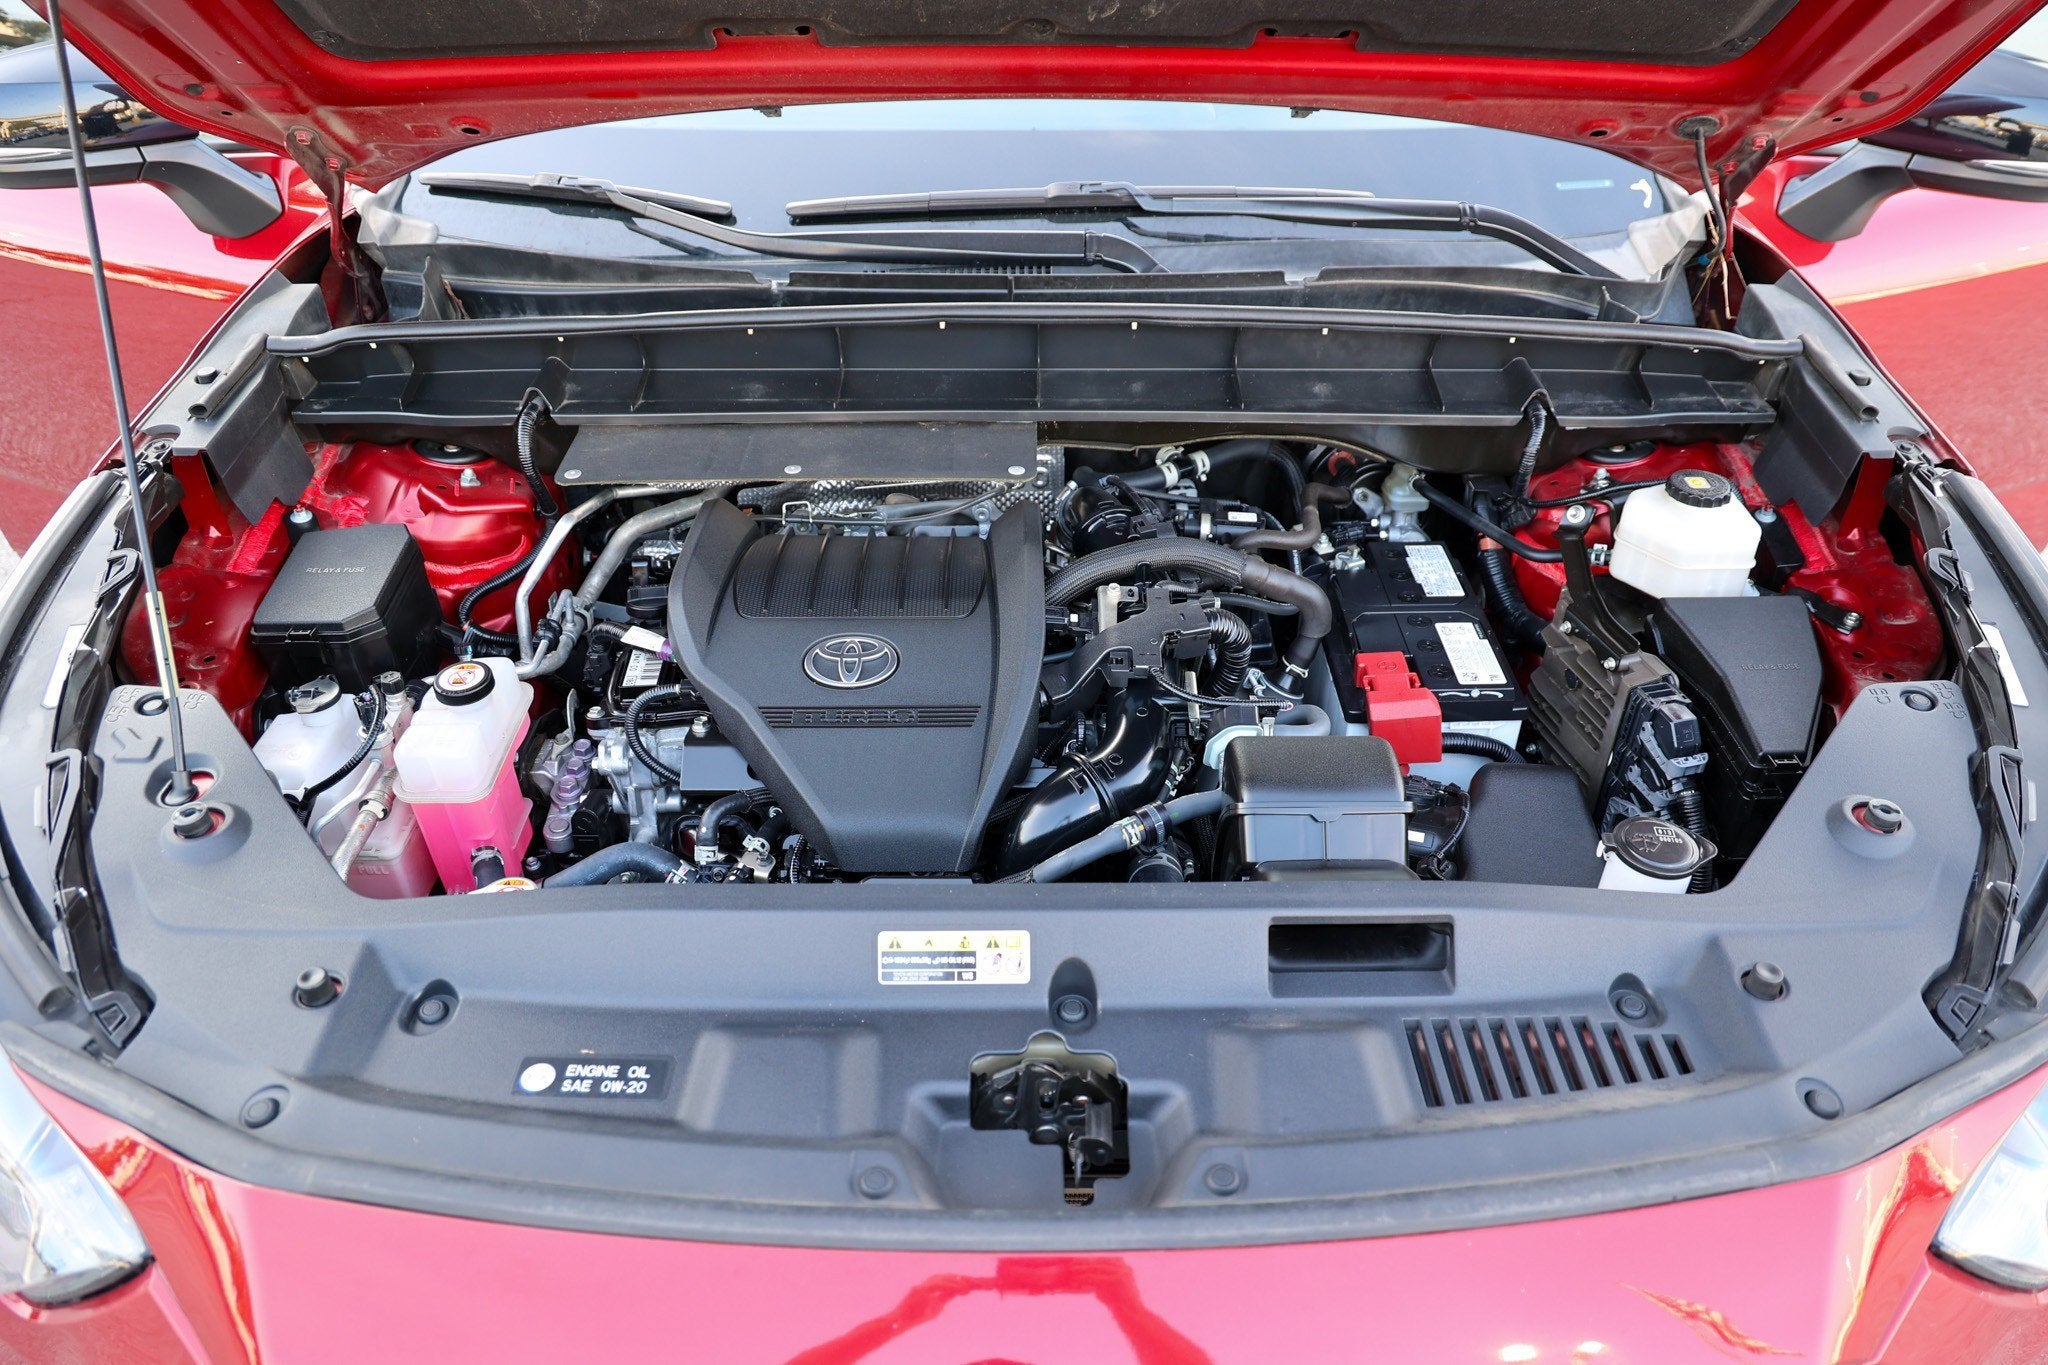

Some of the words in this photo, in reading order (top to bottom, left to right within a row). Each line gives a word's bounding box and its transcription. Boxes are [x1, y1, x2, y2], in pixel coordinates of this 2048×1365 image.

[792, 708, 915, 724] TURBO
[565, 1064, 621, 1078] ENGINE
[627, 1065, 651, 1079] OIL
[560, 1079, 593, 1092] SAE
[600, 1080, 648, 1094] 0W-20
